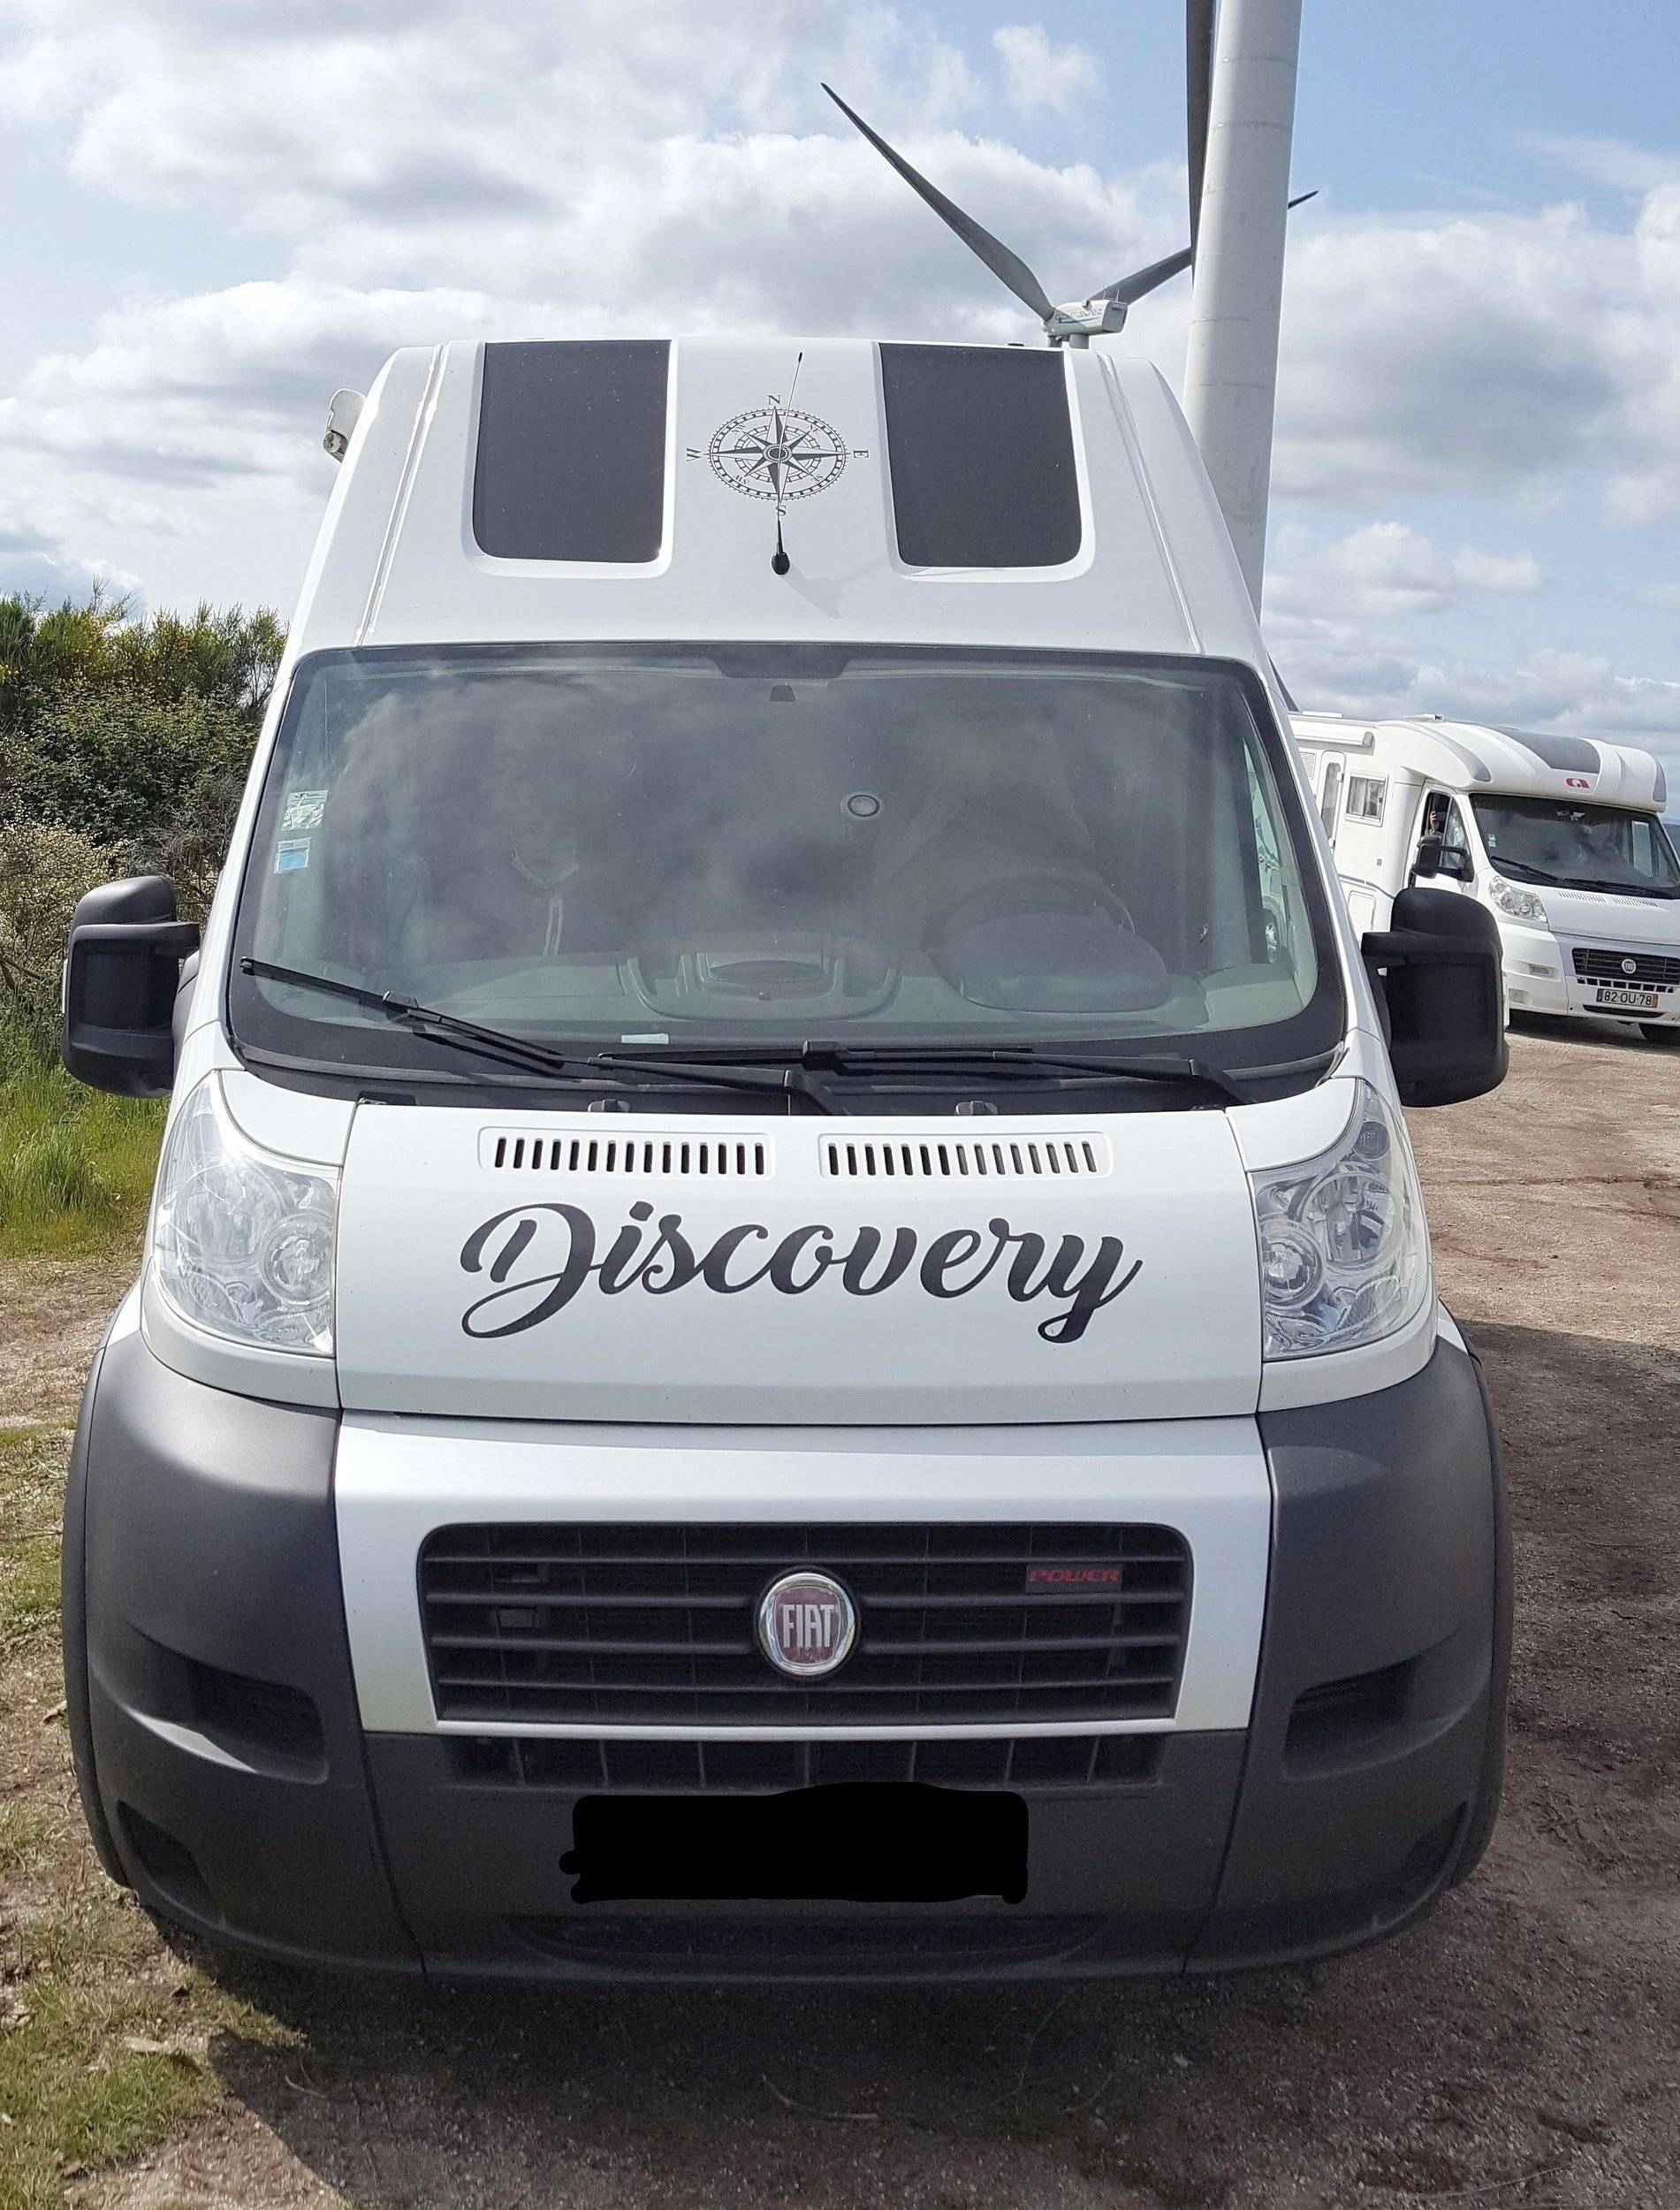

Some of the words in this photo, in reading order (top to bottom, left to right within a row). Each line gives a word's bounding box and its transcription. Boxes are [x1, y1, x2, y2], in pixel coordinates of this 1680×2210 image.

[767, 394, 781, 406] N
[686, 447, 703, 462] W
[853, 449, 870, 460] E
[775, 505, 787, 517] S
[460, 1200, 1144, 1344] Discovery
[1028, 1569, 1120, 1584] POWER
[782, 1604, 835, 1649] FIAT
